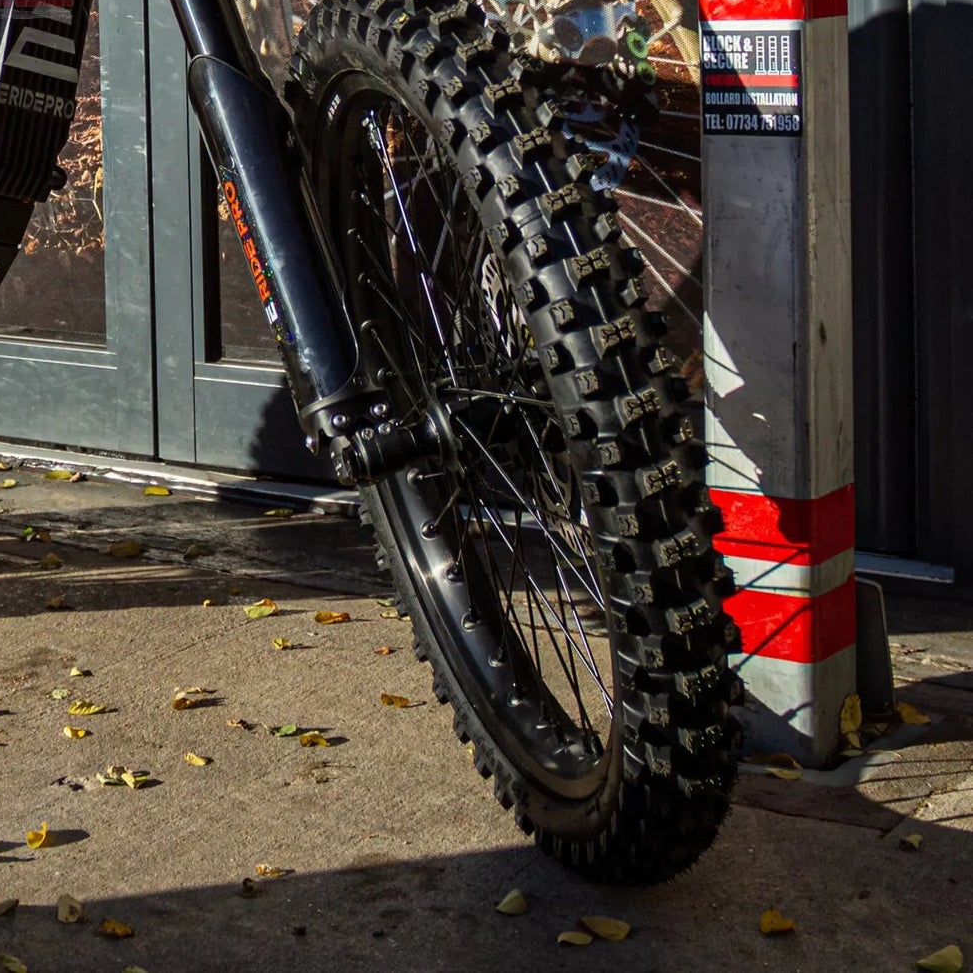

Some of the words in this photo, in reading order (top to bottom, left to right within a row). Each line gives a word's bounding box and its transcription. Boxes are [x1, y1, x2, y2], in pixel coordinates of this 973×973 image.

[703, 35, 742, 52] BLOCK
[743, 37, 753, 52] &
[703, 52, 749, 70] SECURE
[705, 92, 741, 106] BOLLARD
[742, 92, 798, 106] INSTALLATION
[705, 113, 724, 130] TEL:
[726, 113, 759, 131] 07734
[760, 114, 800, 132] 751958
